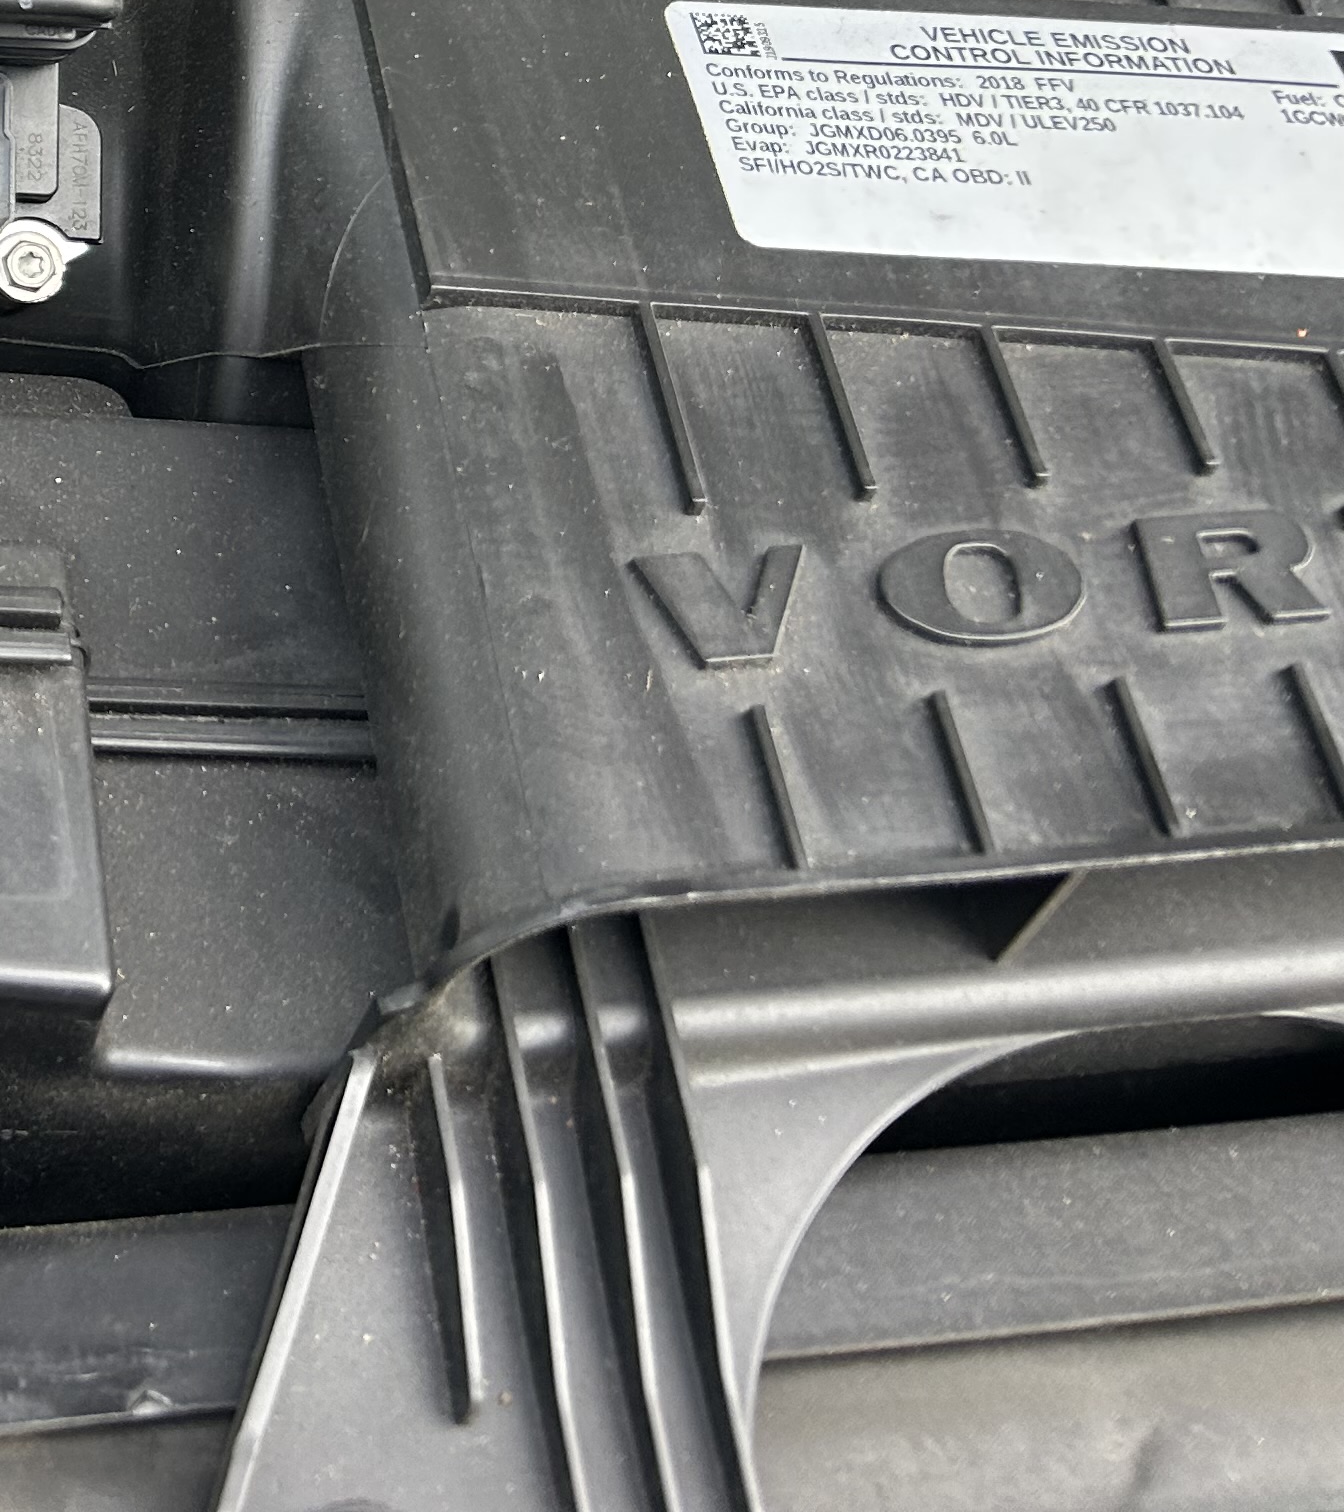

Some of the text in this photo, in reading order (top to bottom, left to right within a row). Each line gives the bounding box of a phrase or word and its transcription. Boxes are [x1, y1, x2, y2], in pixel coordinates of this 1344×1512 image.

[920, 26, 1192, 55] VEHICLE EMISSION
[890, 44, 1237, 76] CONTROL INFORMATION
[705, 62, 1076, 93] Conforms to Regulations: 2018 FFV
[711, 80, 754, 97] U.S.
[759, 84, 801, 102] EPA
[806, 85, 859, 104] class
[875, 90, 928, 107] stds:
[939, 92, 985, 109] HDV
[1004, 94, 1072, 113] TIER3,
[1076, 97, 1101, 112] 40
[1103, 99, 1150, 116] CFR
[719, 99, 817, 120] California
[821, 104, 875, 123] class
[891, 109, 945, 126] stds:
[955, 111, 1004, 128] MDV
[1022, 113, 1118, 133] ULEV250
[725, 118, 1019, 146] Group: JGMXD06.0395 6.0L
[733, 136, 966, 164] Evap: JGMXR0223841
[912, 165, 949, 183] CA
[953, 167, 1010, 186] OBD:
[626, 505, 1344, 670] VOR
